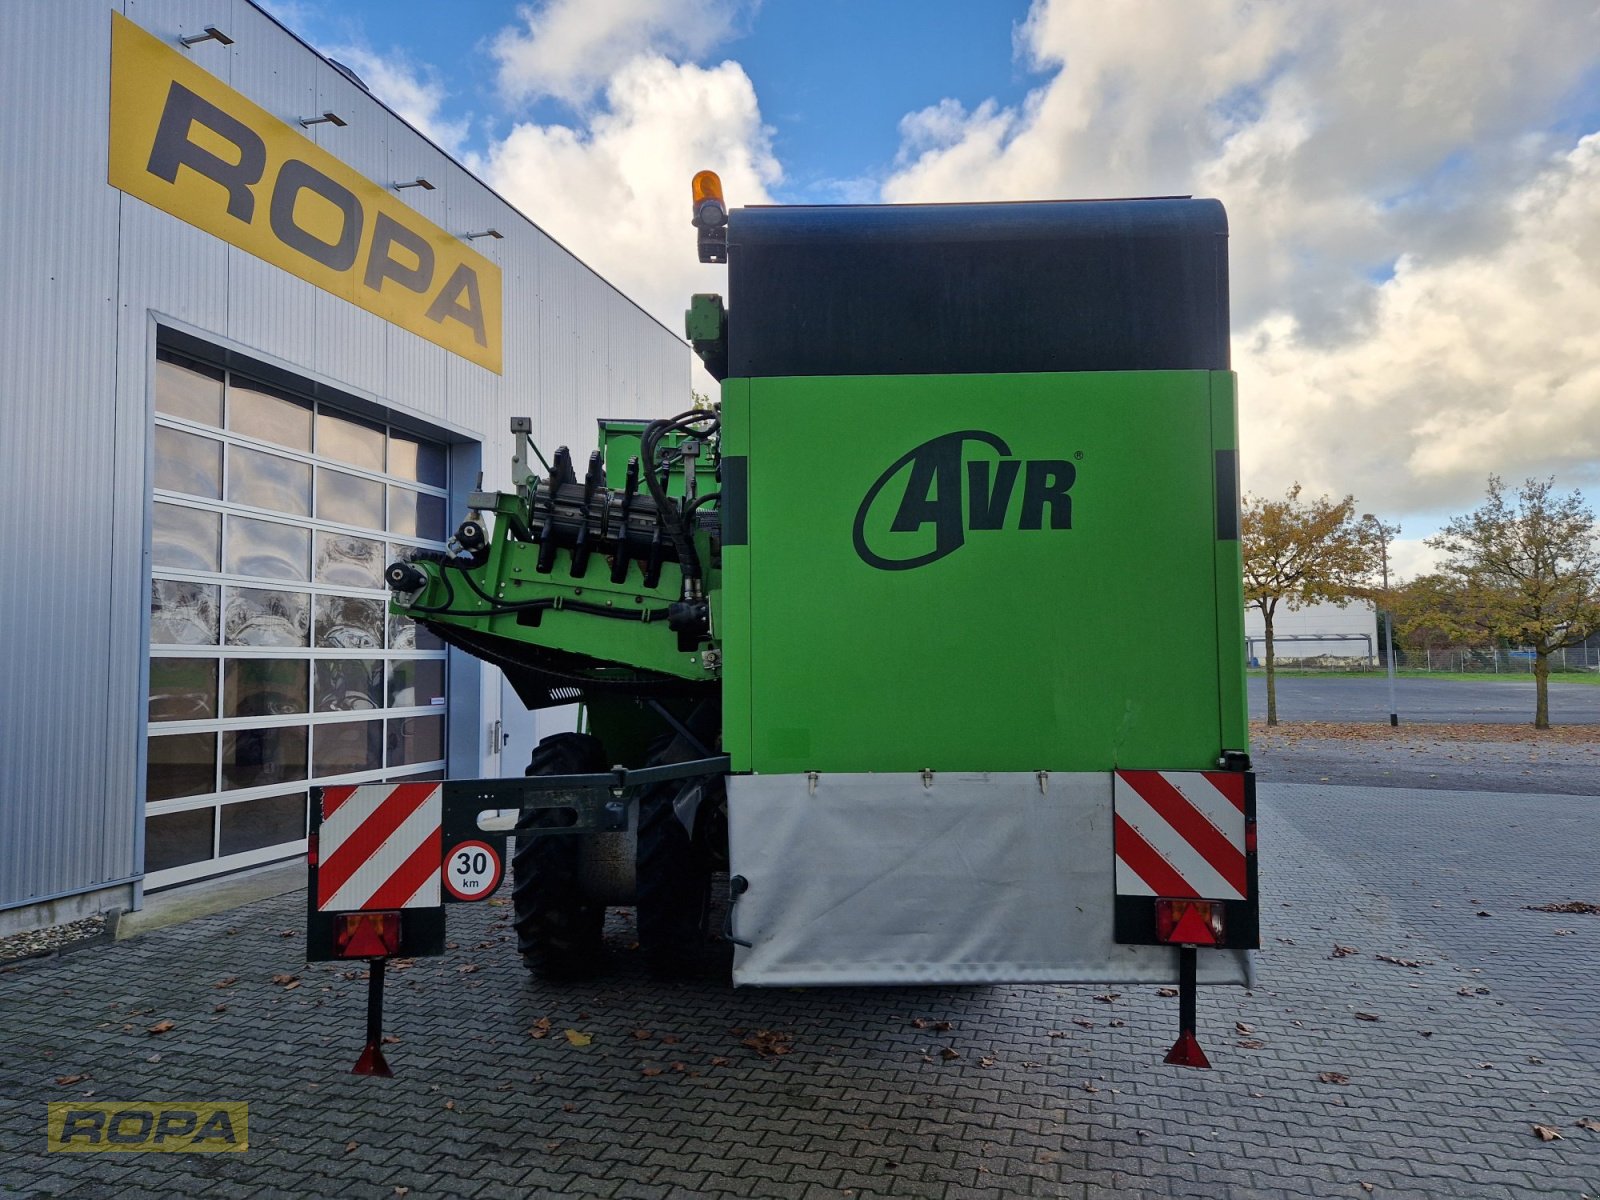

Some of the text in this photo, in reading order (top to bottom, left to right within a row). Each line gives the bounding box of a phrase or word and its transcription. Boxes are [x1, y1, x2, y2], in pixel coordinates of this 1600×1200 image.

[146, 80, 488, 348] ROPA
[853, 430, 1077, 571] AVR
[456, 852, 487, 875] 30
[462, 878, 479, 888] km
